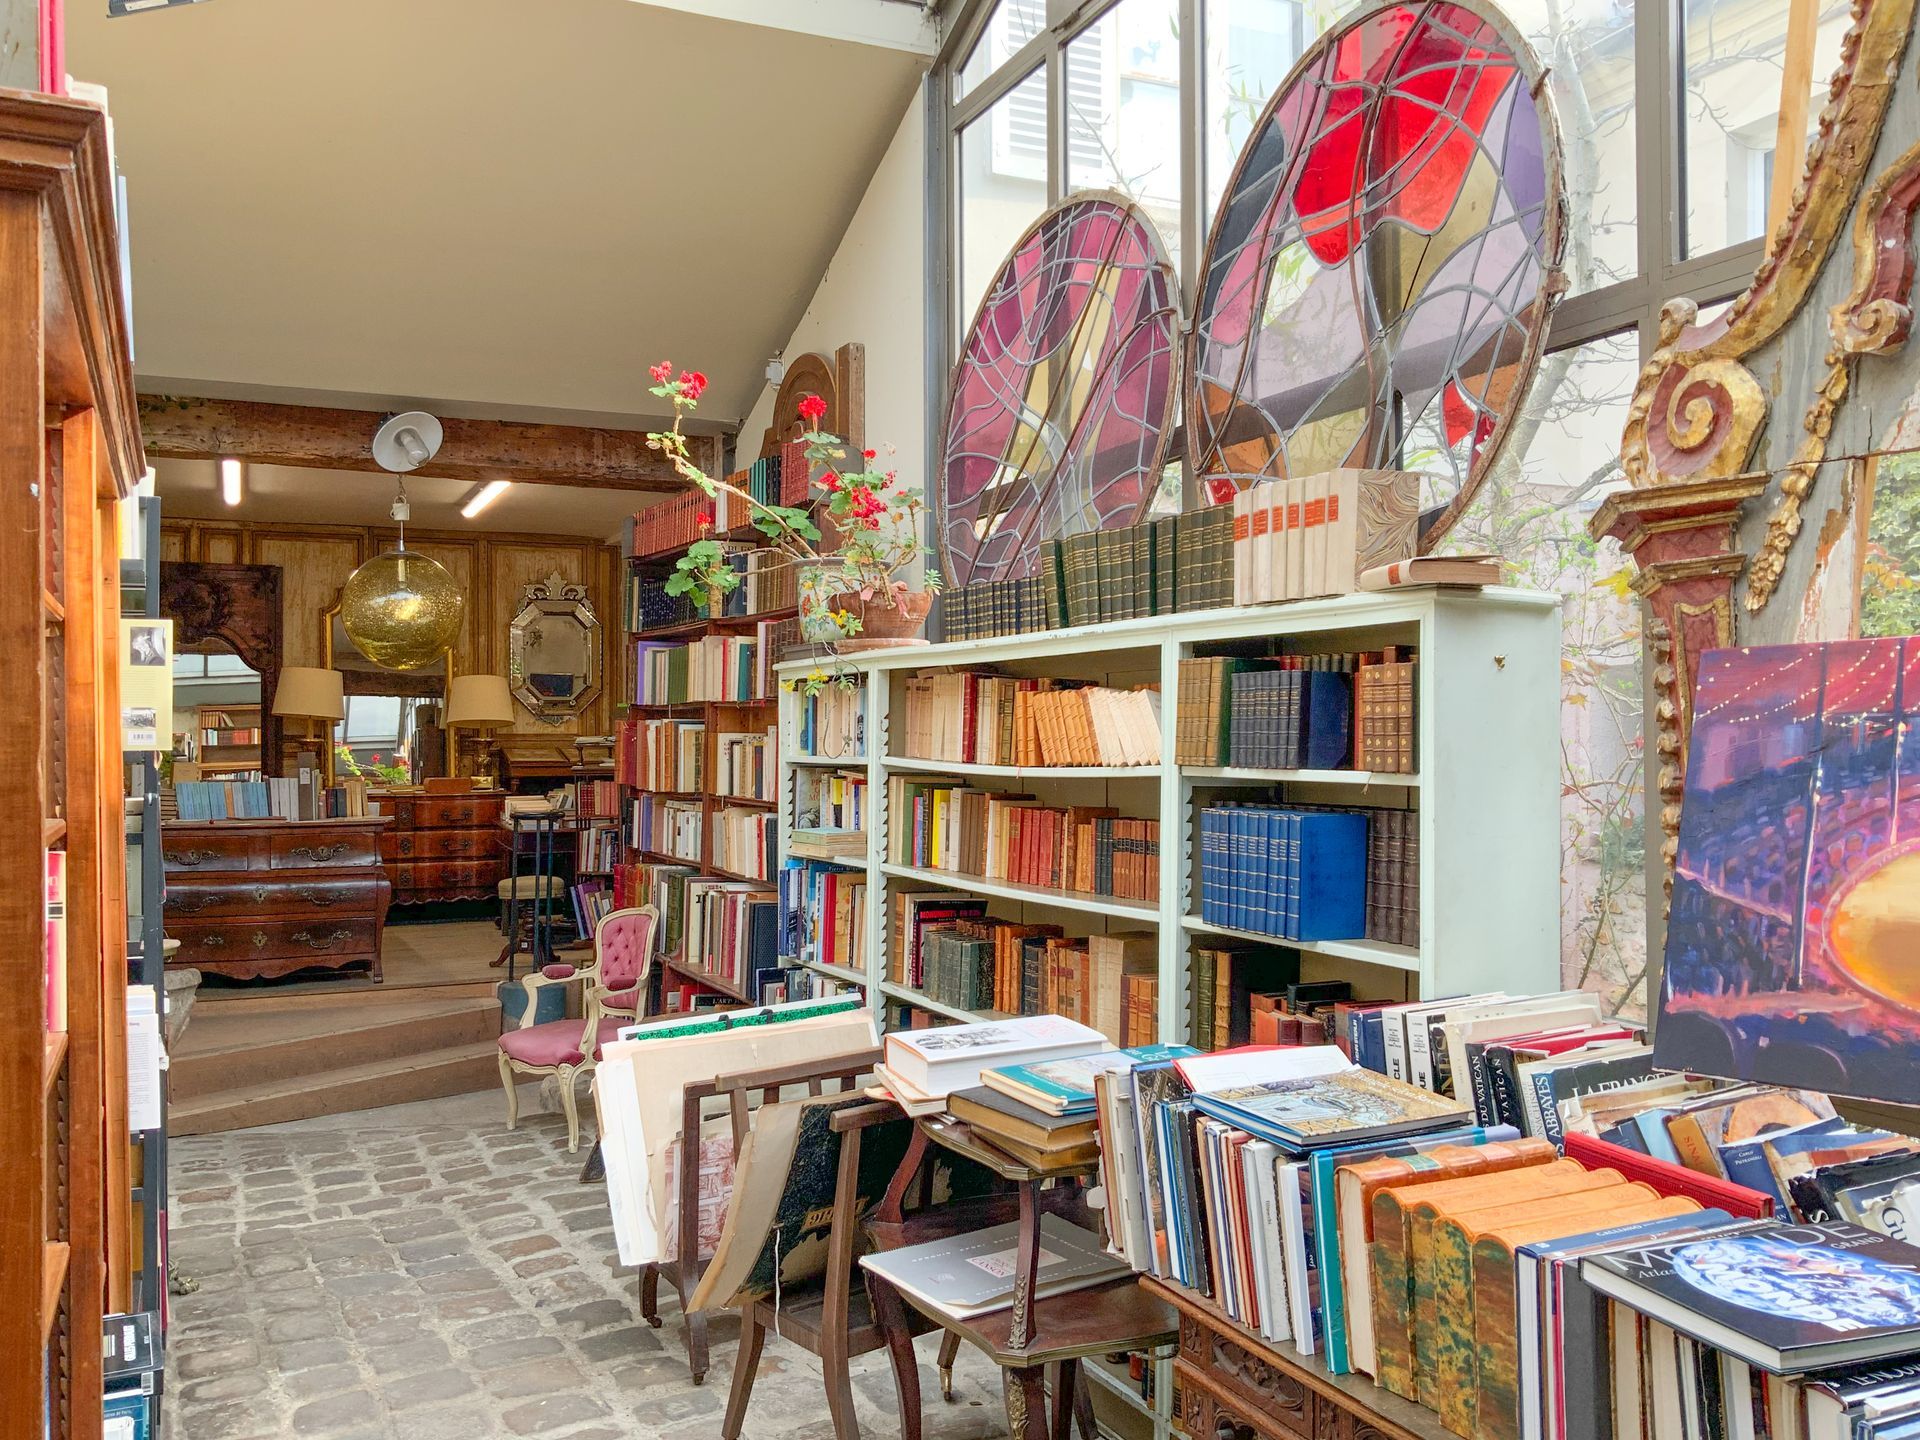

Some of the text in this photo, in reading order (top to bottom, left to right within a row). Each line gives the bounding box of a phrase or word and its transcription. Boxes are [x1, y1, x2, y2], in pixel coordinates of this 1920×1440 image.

[1471, 1055, 1486, 1103] VATICAN
[1495, 1058, 1509, 1118] VATICAN
[1479, 1104, 1489, 1122] DU
[1535, 1076, 1561, 1138] ABBAYES
[1830, 1235, 1885, 1251] GRAND
